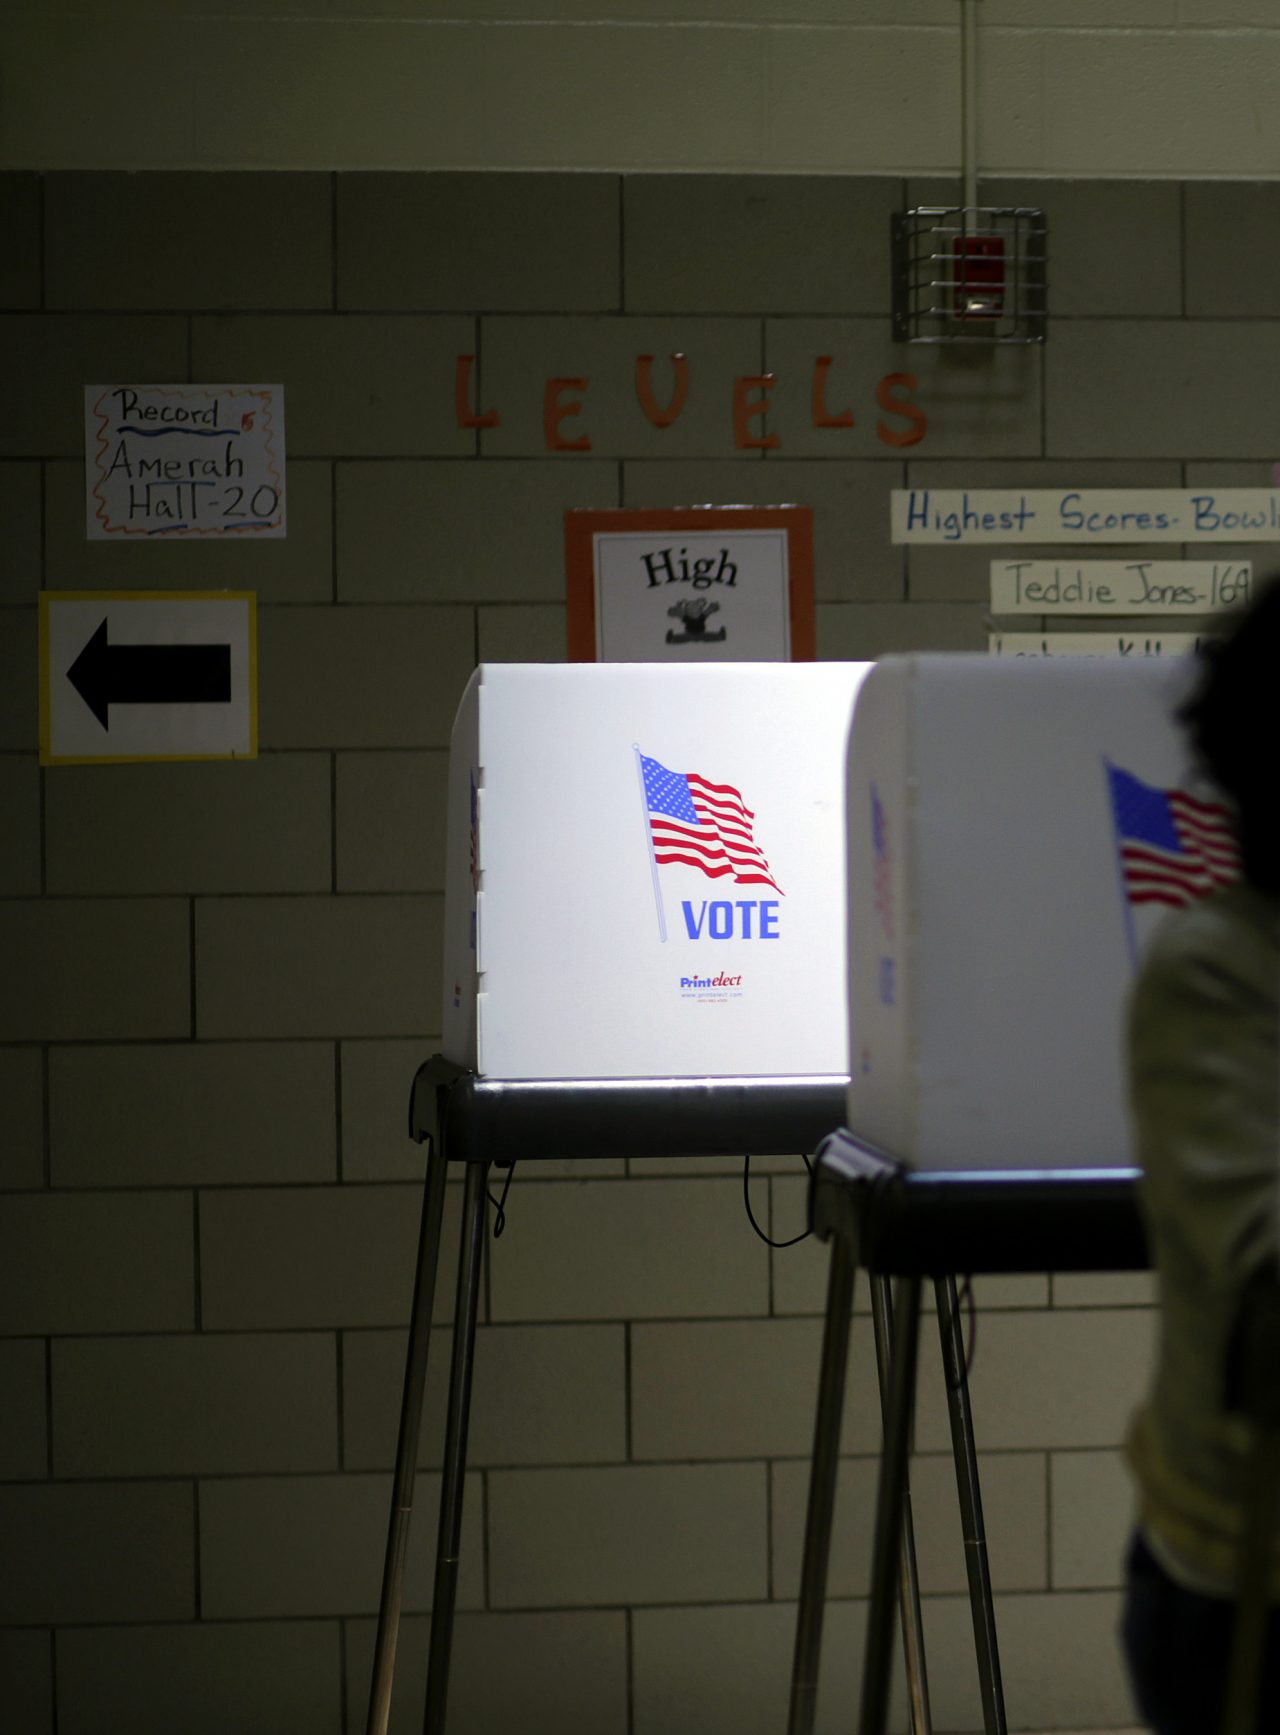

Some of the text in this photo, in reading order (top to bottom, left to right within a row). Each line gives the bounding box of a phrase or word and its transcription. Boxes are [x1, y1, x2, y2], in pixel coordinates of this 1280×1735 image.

[112, 388, 219, 428] Record
[455, 352, 928, 451] LEVELS
[105, 439, 244, 482] Amerah
[907, 490, 1035, 541] Highest
[640, 547, 738, 588] High
[1005, 562, 1117, 605] Teddie
[680, 900, 780, 940] VOTE
[680, 971, 743, 988] Printelect
